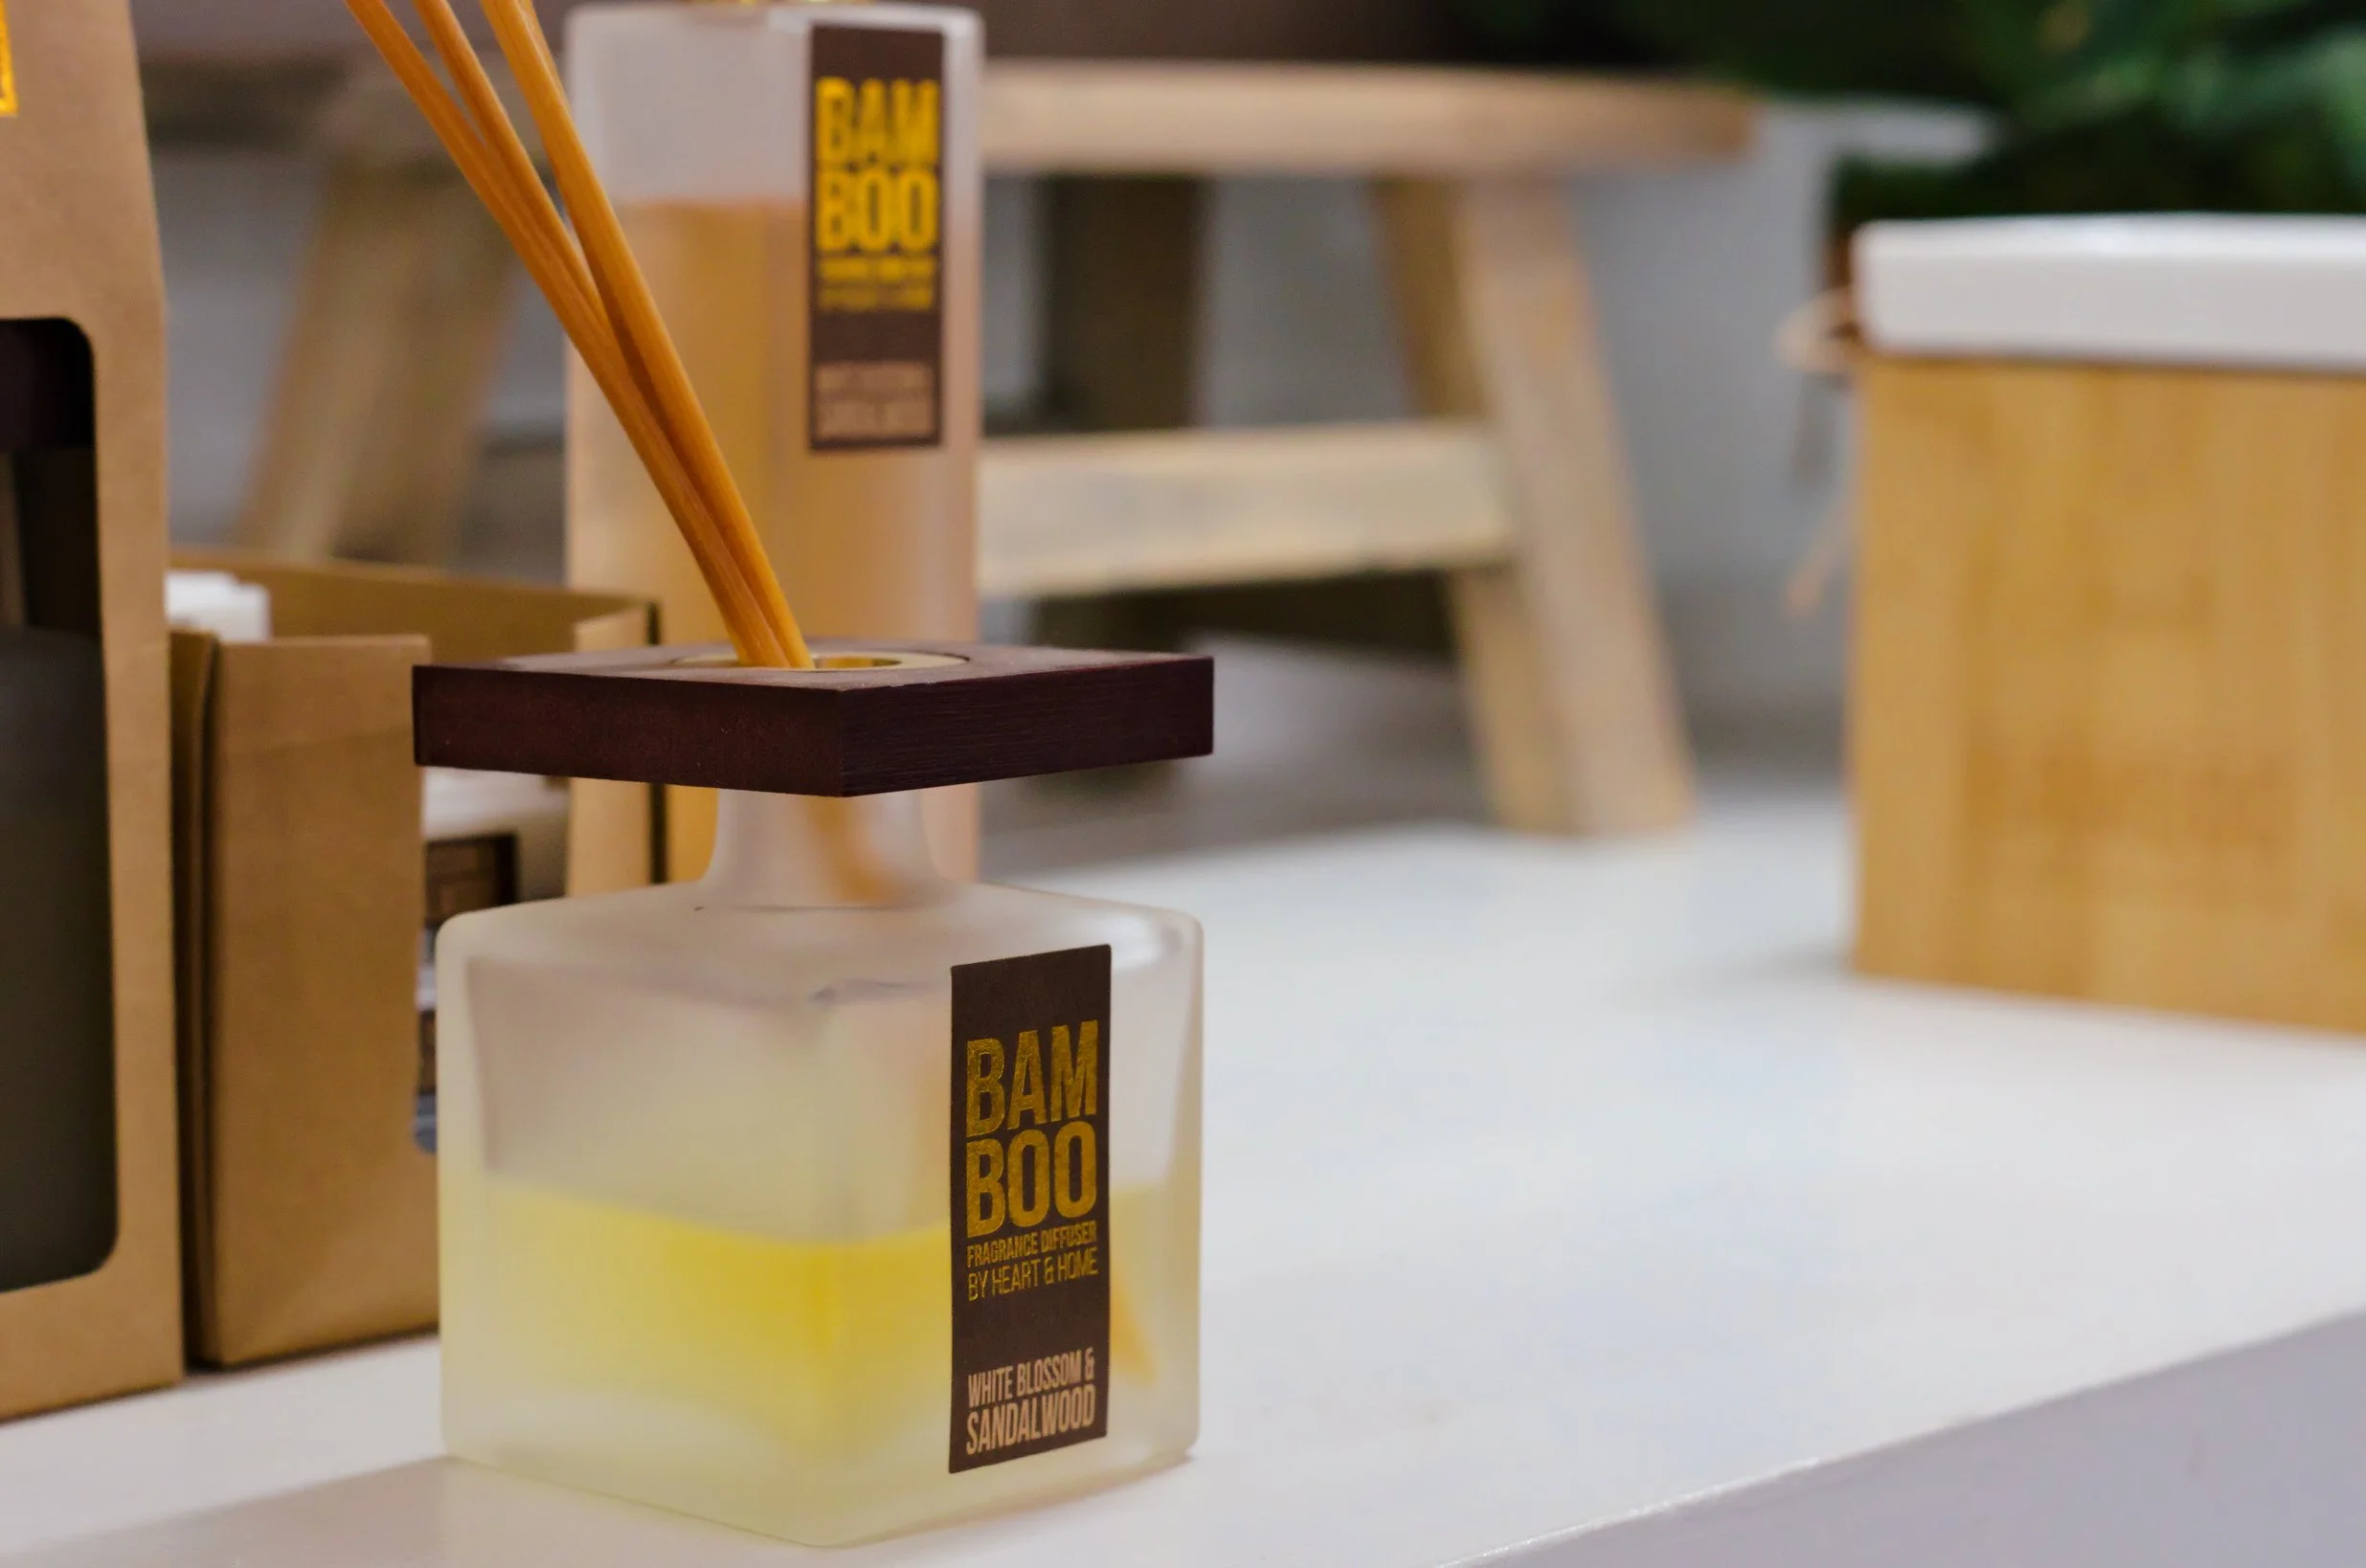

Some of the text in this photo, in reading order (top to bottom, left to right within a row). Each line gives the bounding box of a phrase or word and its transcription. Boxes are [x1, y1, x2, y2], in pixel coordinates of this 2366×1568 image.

[817, 76, 939, 164] BAM
[817, 168, 938, 251] BOO
[966, 1019, 1098, 1137] BAM
[966, 1121, 1097, 1239] BOO
[966, 1220, 1097, 1268] FRAGRANCE DIFFUSER
[968, 1246, 1098, 1302] BY HEART & HOME
[968, 1346, 1095, 1408] WHITE BLOSSOM &
[966, 1382, 1096, 1456] SANDALWOOD
